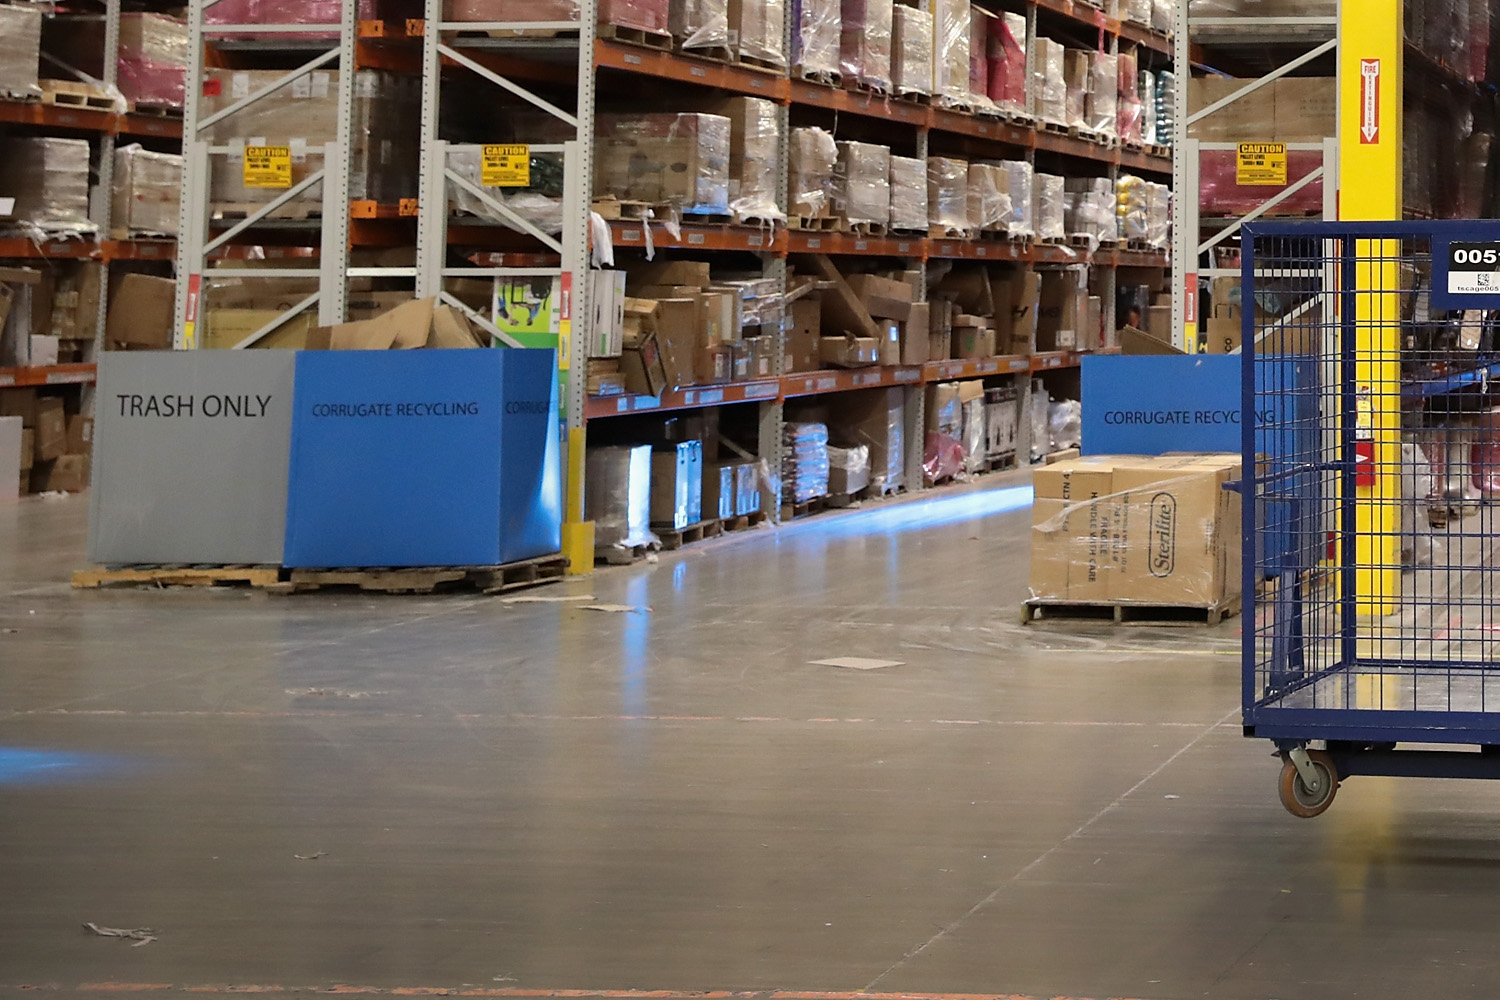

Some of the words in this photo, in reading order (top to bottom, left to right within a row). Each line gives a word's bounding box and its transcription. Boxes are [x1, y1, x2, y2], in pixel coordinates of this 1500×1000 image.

[485, 147, 526, 156] CAUTION
[1241, 144, 1282, 153] CAUTION
[117, 394, 194, 417] TRASH
[202, 394, 272, 417] ONLY
[312, 403, 392, 417] CORRUGATE
[396, 402, 479, 416] RECYCLING
[505, 401, 550, 414] CORRUGA
[1104, 411, 1190, 425] CORRUGATE
[1194, 410, 1275, 424] RECYCNG
[1088, 492, 1098, 529] HNDLE
[1154, 504, 1171, 571] Sterilite
[1088, 558, 1097, 582] CARE
